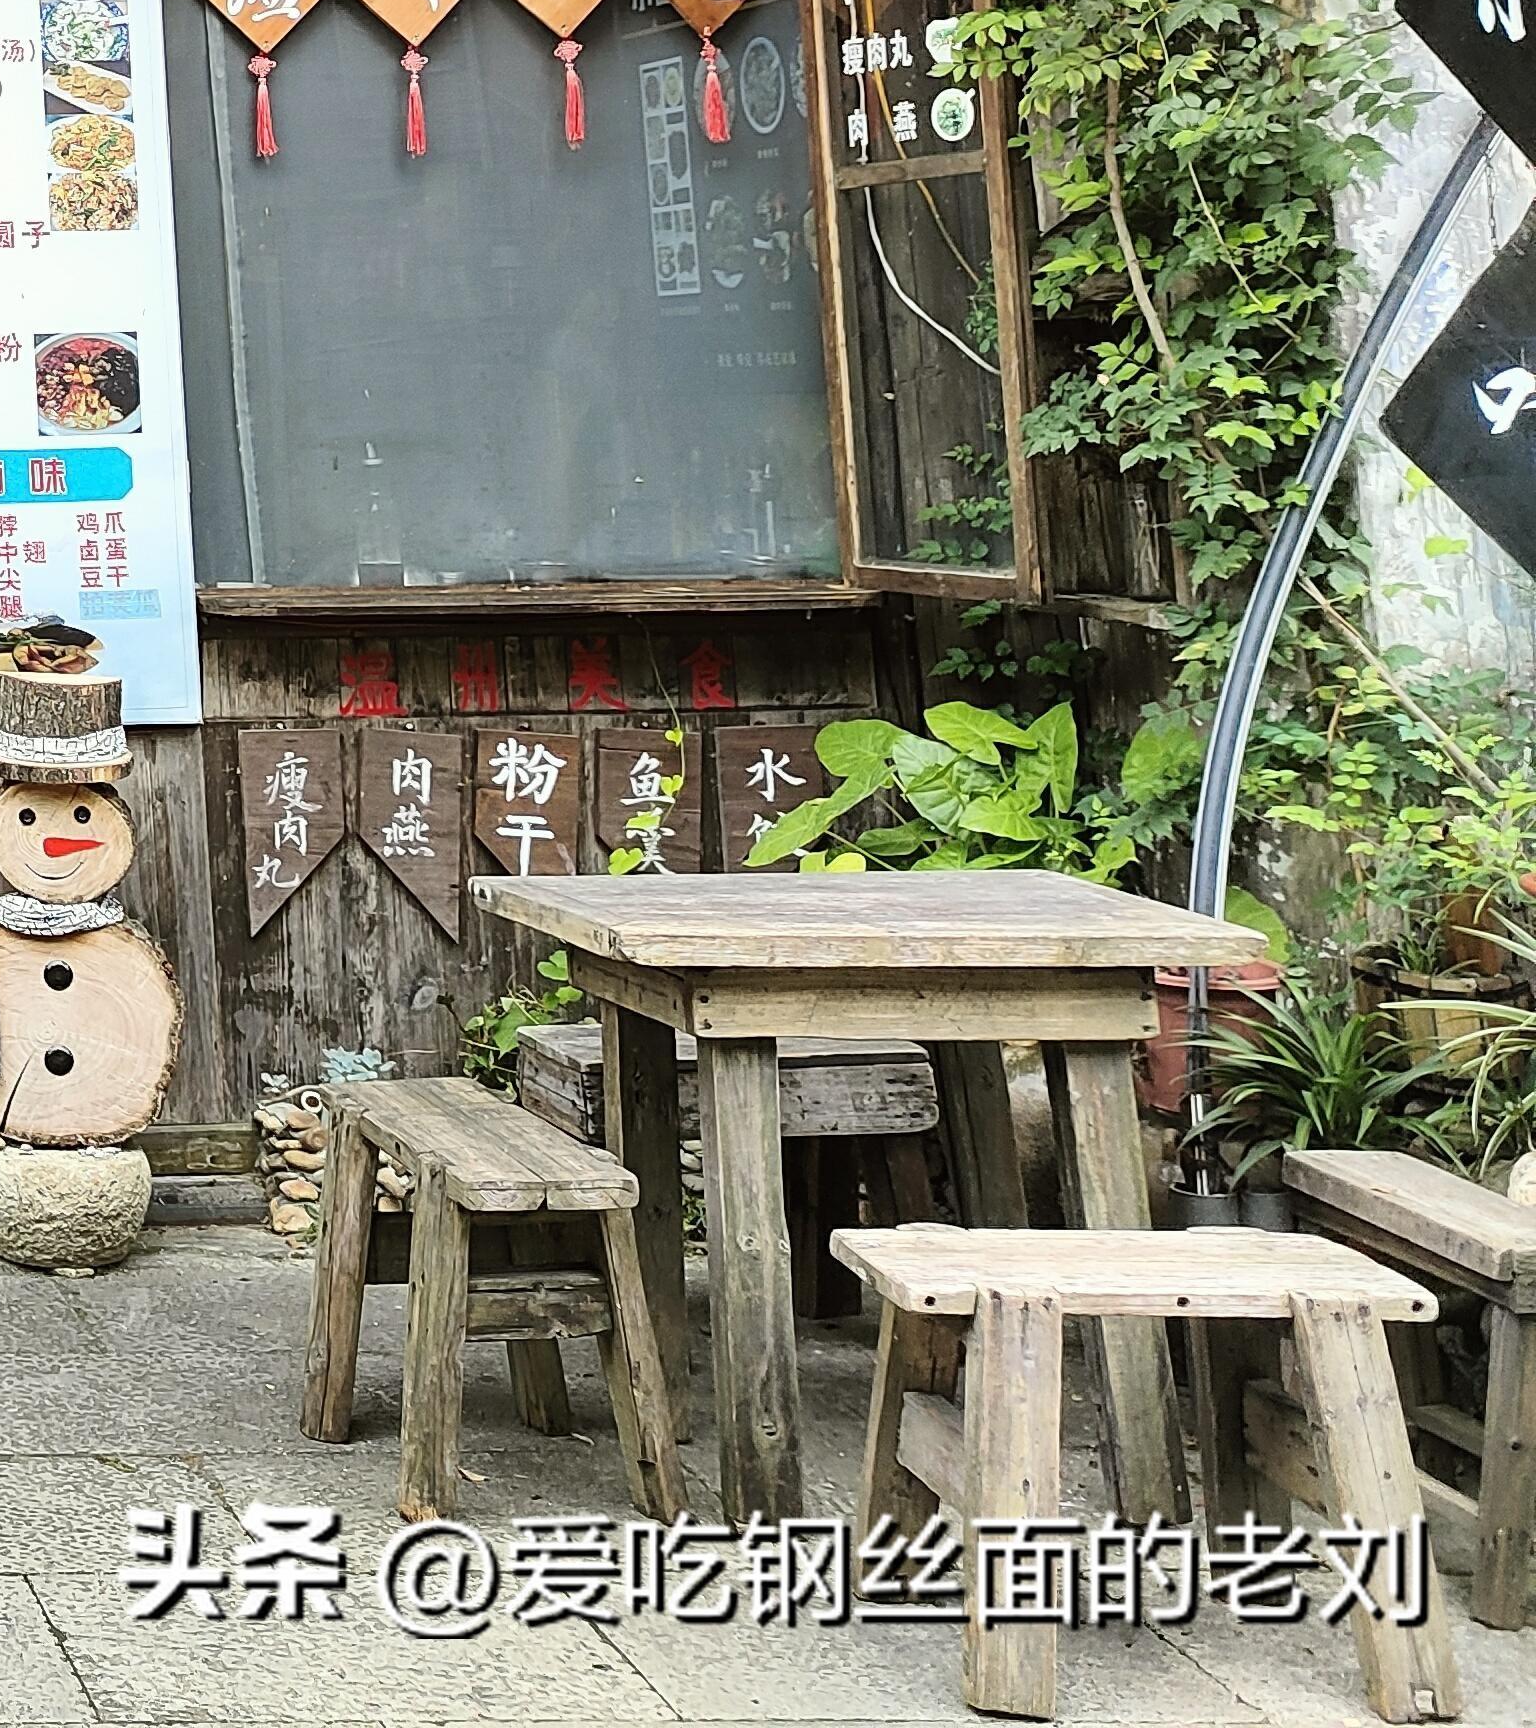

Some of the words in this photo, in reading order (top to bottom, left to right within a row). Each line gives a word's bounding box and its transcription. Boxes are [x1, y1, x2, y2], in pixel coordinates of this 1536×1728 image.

[841, 28, 913, 77] 瘦肉丸
[848, 100, 918, 148] 肉燕
[76, 512, 126, 534] 鸡爪
[79, 538, 127, 562] 卤蛋
[79, 565, 129, 588] 豆干
[339, 637, 737, 718] 温州美食
[251, 751, 324, 889] 瘦肉丸
[382, 748, 436, 859] 肉燕
[489, 737, 568, 876] 粉干
